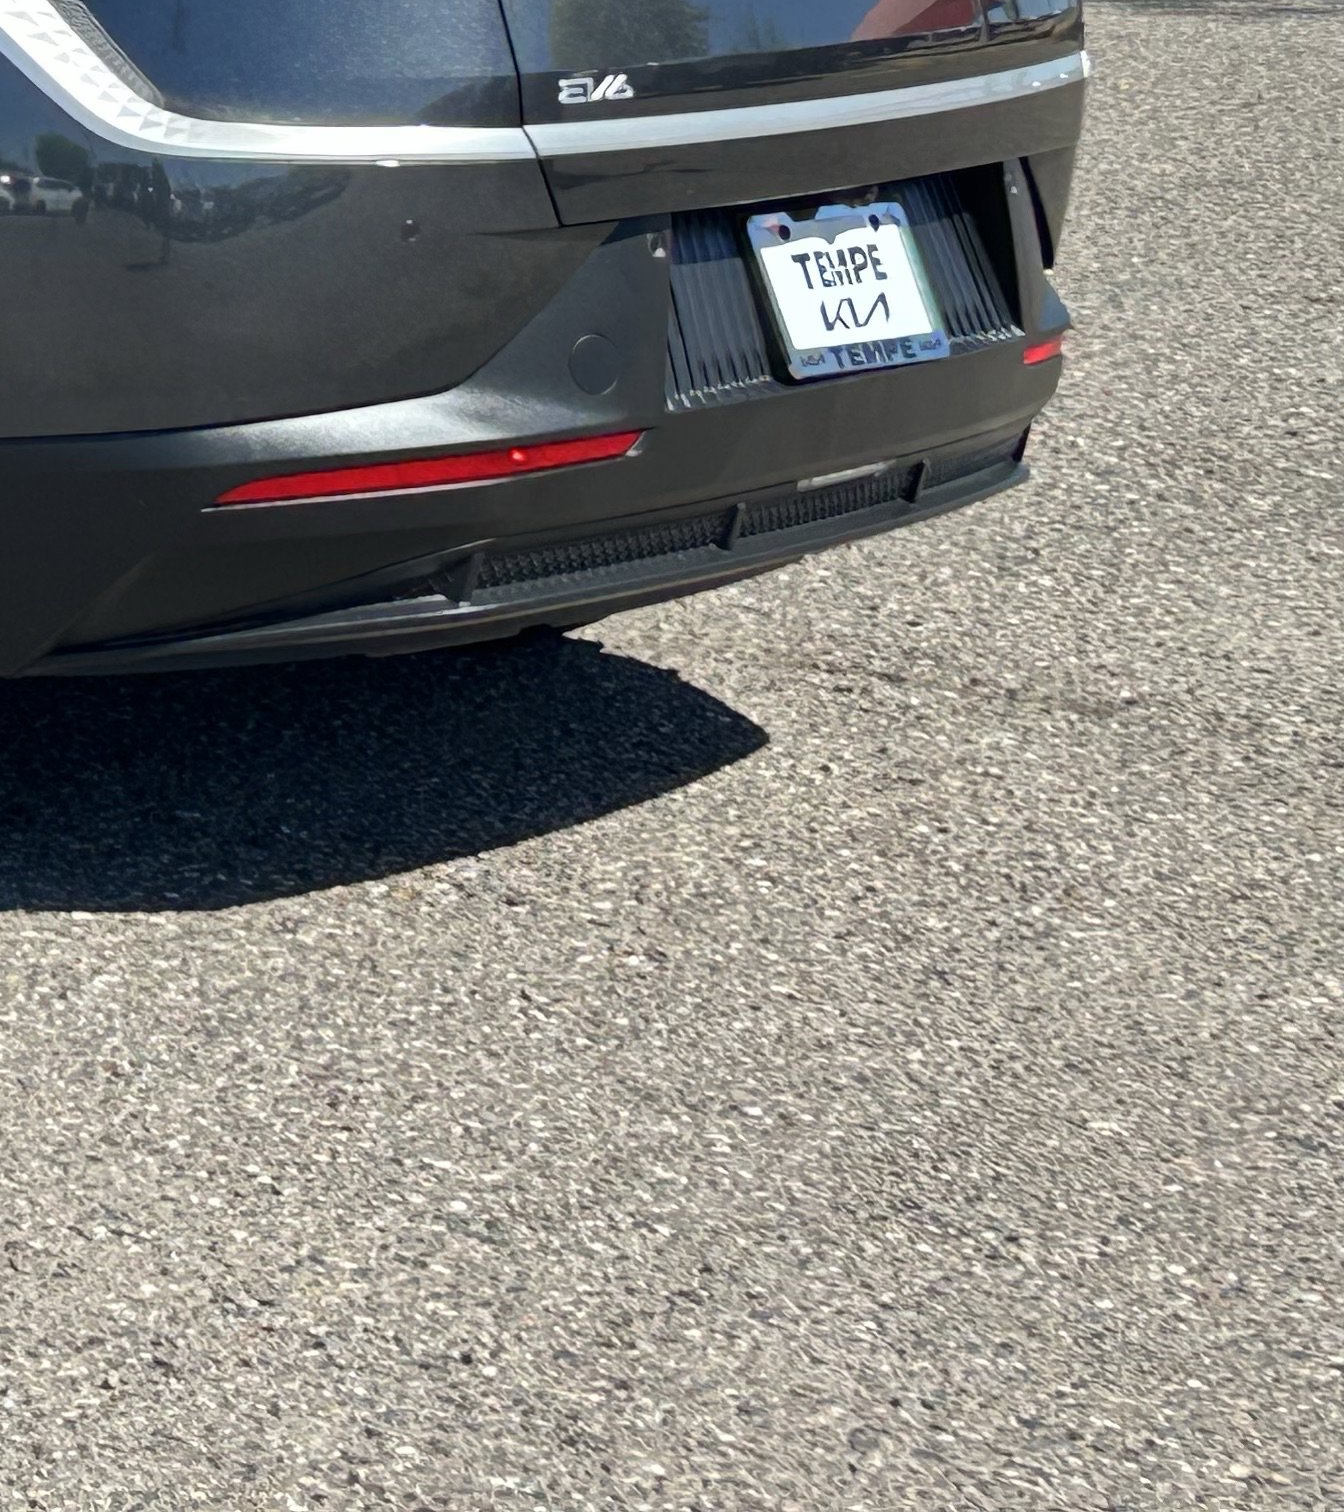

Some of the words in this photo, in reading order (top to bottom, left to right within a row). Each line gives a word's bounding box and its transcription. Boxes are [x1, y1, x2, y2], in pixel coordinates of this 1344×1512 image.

[558, 73, 634, 104] EV6
[791, 244, 888, 289] TEMPE
[820, 292, 890, 331] KIA
[827, 339, 917, 369] TEMPE
